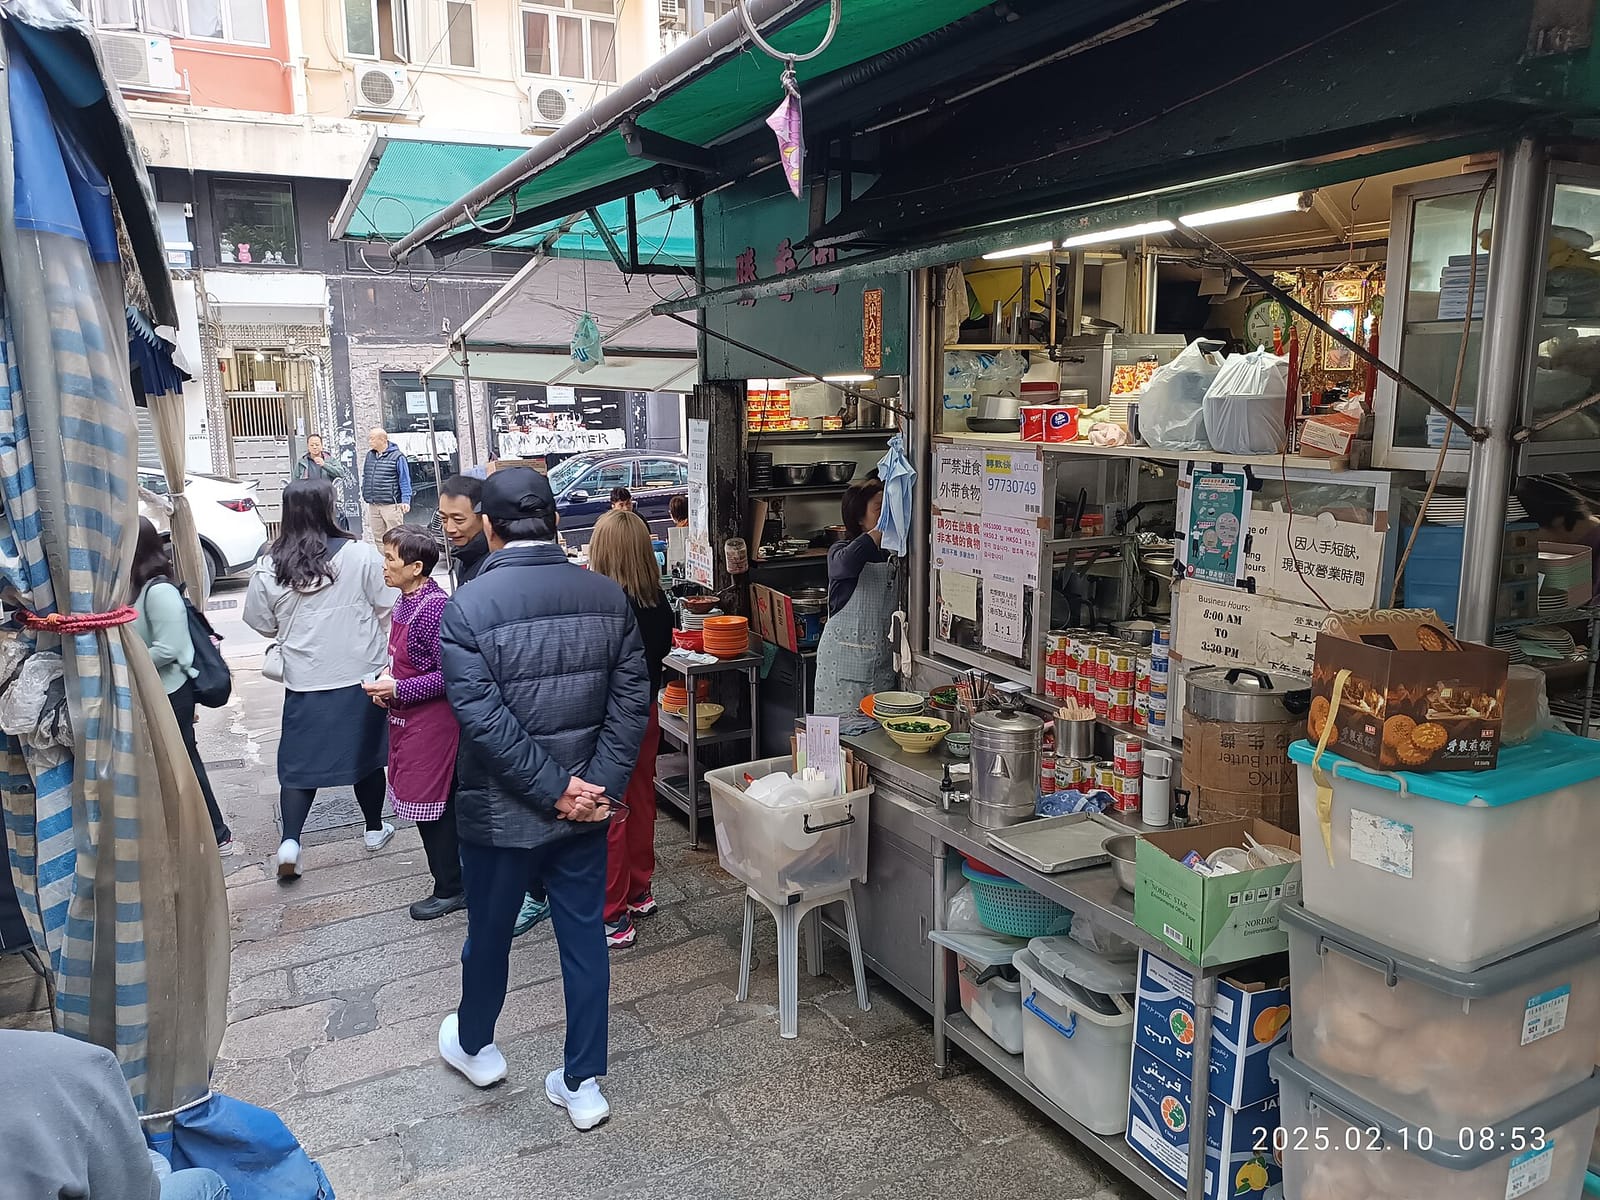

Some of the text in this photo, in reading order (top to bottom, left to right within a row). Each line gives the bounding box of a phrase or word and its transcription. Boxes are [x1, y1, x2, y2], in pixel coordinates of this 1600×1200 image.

[941, 457, 981, 476] 严禁进食
[939, 481, 980, 501] 外带食物
[987, 478, 1036, 495] 97730749
[1259, 526, 1268, 535] of
[1294, 536, 1360, 560] 因人手短缺,
[1281, 557, 1365, 586] 現更改營業時間
[1198, 595, 1251, 612] Business Hours:
[1203, 609, 1242, 626] 8:00 AM
[994, 622, 1011, 636] 1:1
[1215, 627, 1228, 639] TO
[1201, 640, 1239, 659] 3:30 PM
[1219, 752, 1291, 768] nut Butter
[1245, 915, 1275, 929] NORDIC
